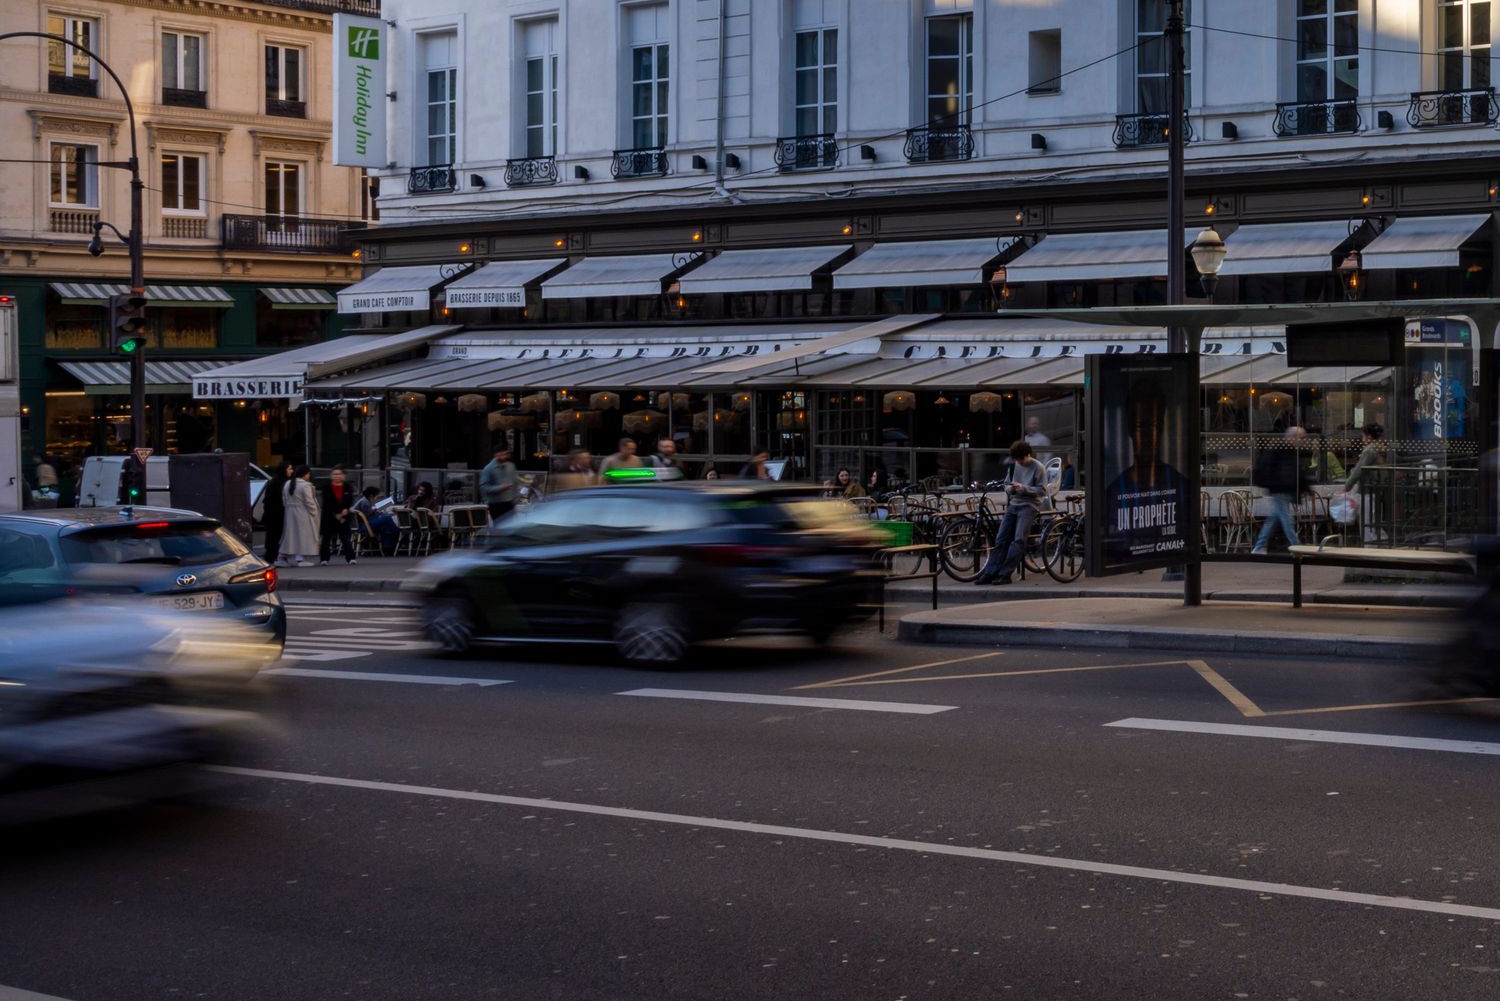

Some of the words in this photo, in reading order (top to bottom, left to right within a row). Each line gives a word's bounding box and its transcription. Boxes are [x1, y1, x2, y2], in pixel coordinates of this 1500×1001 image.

[352, 65, 372, 128] Holiday
[356, 129, 372, 155] Inn
[352, 298, 371, 309] GRAND
[371, 297, 385, 308] CAFE
[386, 296, 414, 307] COMPTOIR
[450, 292, 482, 304] BRASSERIE
[483, 292, 505, 303] DEPUIS
[903, 345, 1005, 359] CAFE
[1030, 345, 1077, 358] LE
[197, 380, 303, 396] BRASSERIE
[1433, 361, 1442, 438] BROOKS
[1117, 507, 1130, 531] UN
[1132, 500, 1177, 528] PROPHÈTE
[1156, 539, 1185, 551] CANAL+
